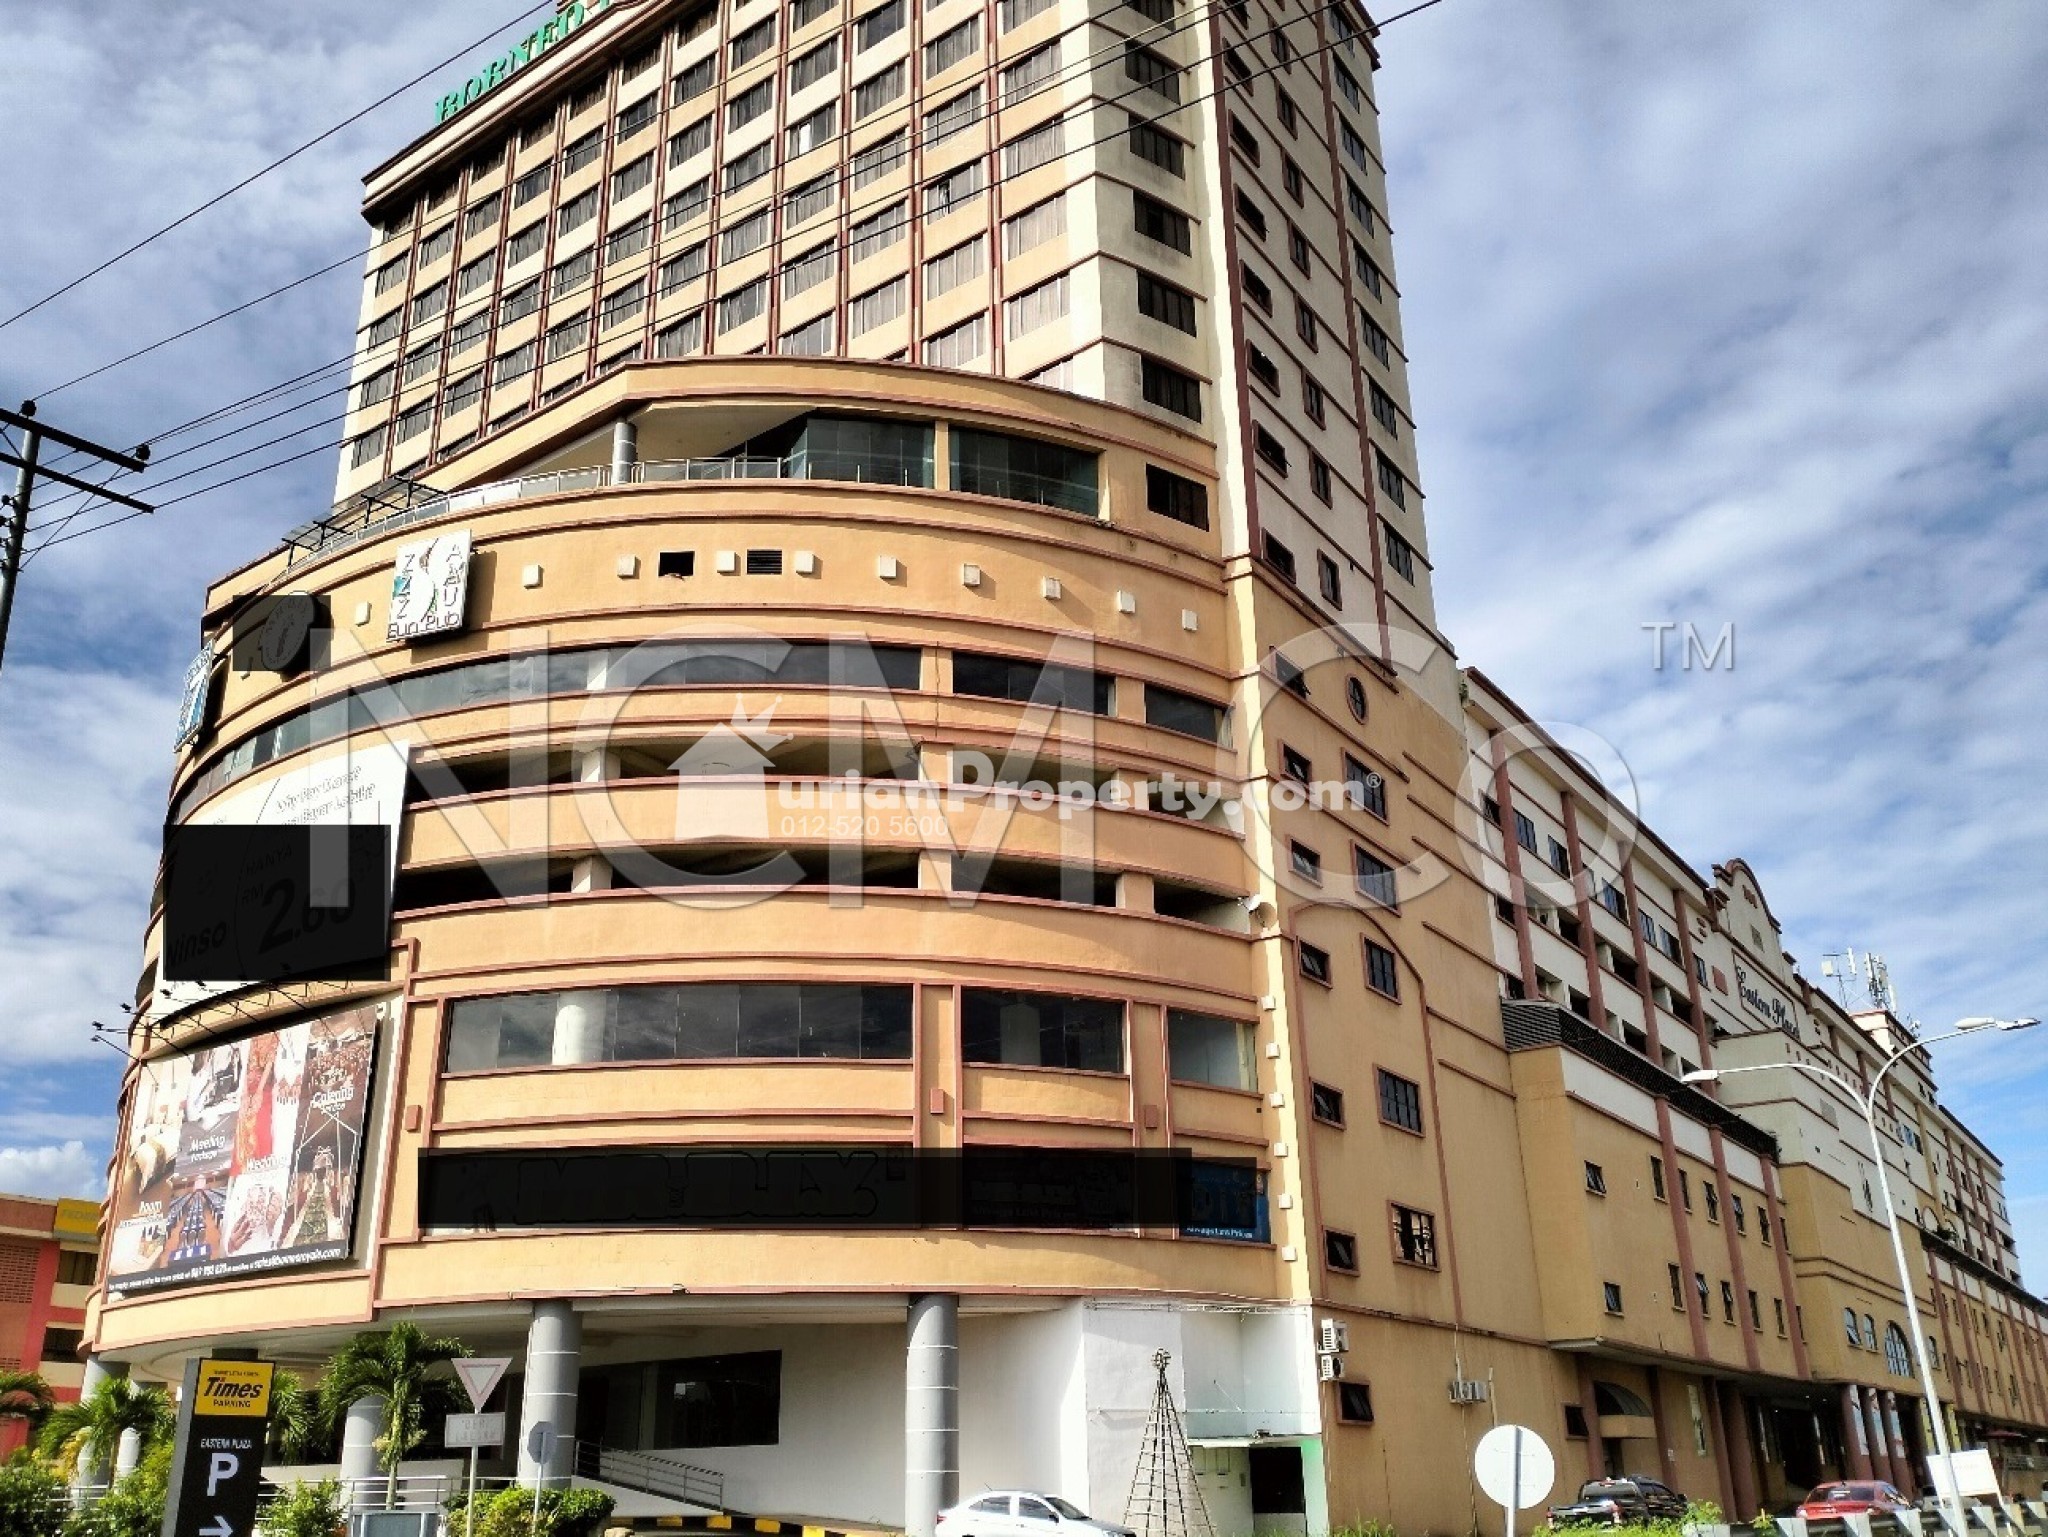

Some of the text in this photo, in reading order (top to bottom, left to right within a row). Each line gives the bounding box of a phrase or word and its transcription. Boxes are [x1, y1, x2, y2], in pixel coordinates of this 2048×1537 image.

[434, 4, 585, 124] BORNEO
[204, 1377, 263, 1398] Times
[213, 1399, 251, 1408] PARKING
[232, 1438, 253, 1449] PLAZA
[207, 1453, 239, 1497] P
